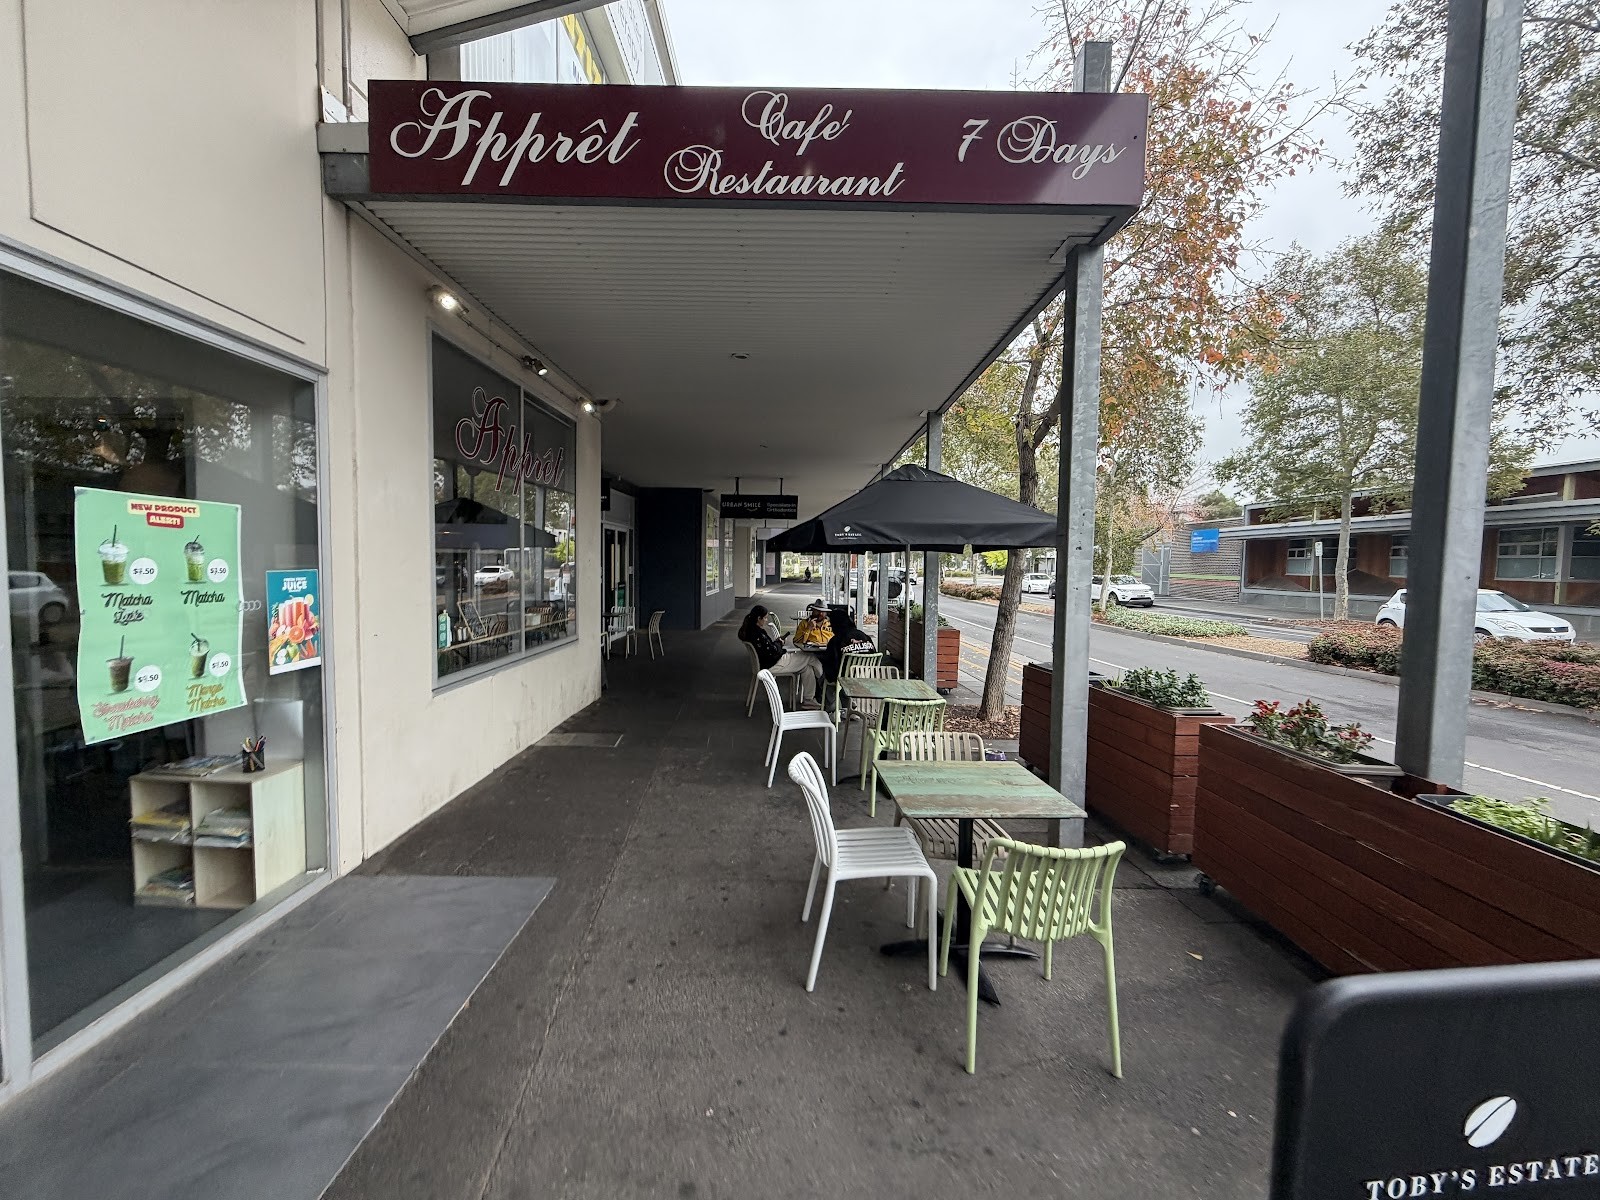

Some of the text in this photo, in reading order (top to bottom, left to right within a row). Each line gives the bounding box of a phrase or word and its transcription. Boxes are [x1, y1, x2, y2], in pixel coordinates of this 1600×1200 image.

[390, 87, 641, 187] Apprêt
[741, 90, 853, 156] Café
[958, 115, 1127, 180] 7 Days
[664, 144, 904, 197] Restaurant
[456, 386, 565, 496] Apprêt
[131, 502, 197, 514] NEW PRODUCT
[101, 592, 154, 609] Matcha
[180, 589, 226, 607] Matcha
[281, 580, 308, 591] JUICE
[1366, 1153, 1599, 1200] TOBY'S ESTATE
